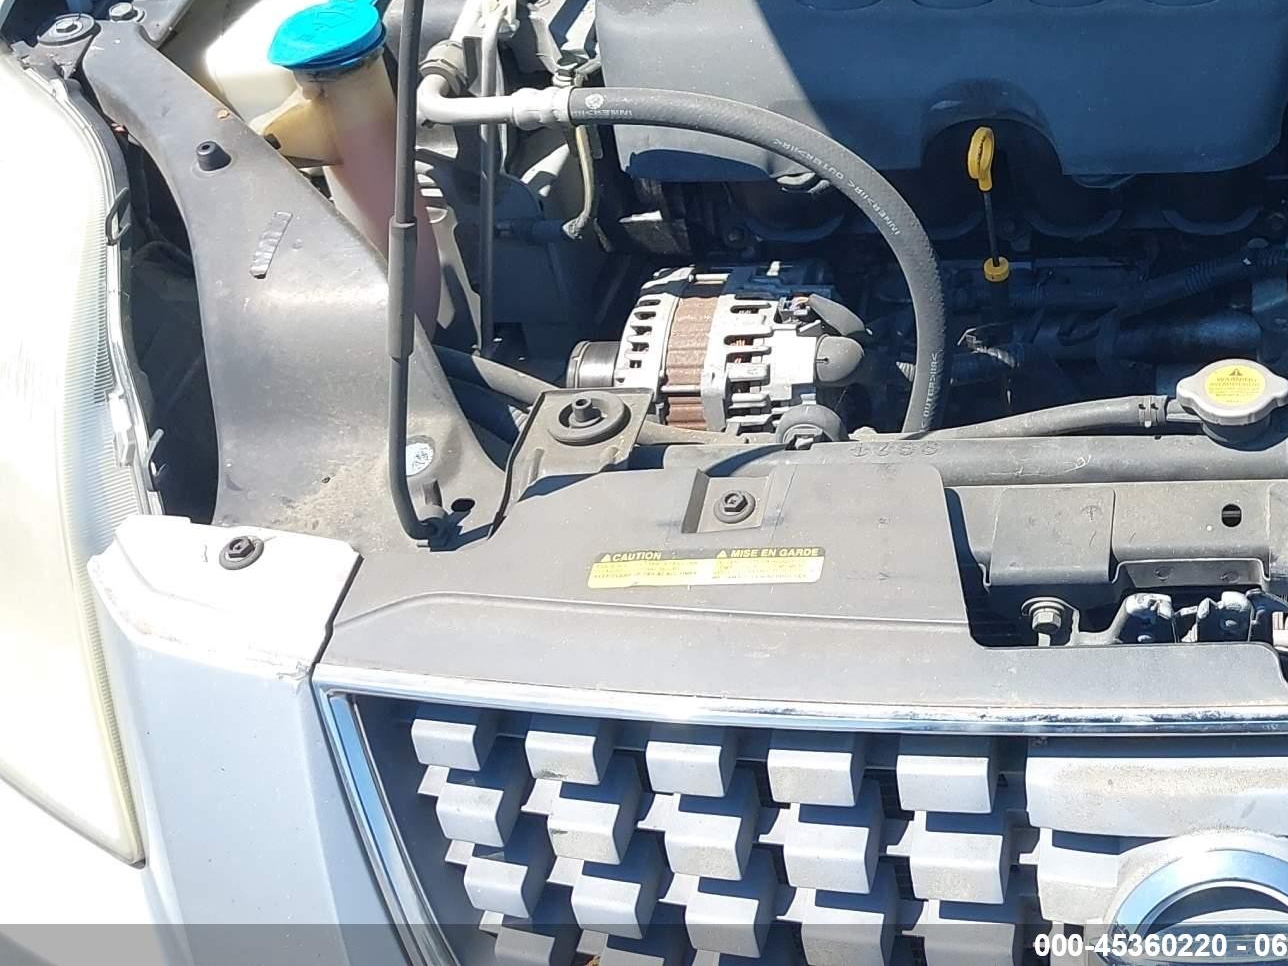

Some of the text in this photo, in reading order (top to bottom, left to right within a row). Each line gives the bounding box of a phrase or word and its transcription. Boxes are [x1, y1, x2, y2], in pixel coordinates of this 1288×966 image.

[612, 552, 662, 562] CAUTION
[730, 548, 820, 558] MISE EN GARDE
